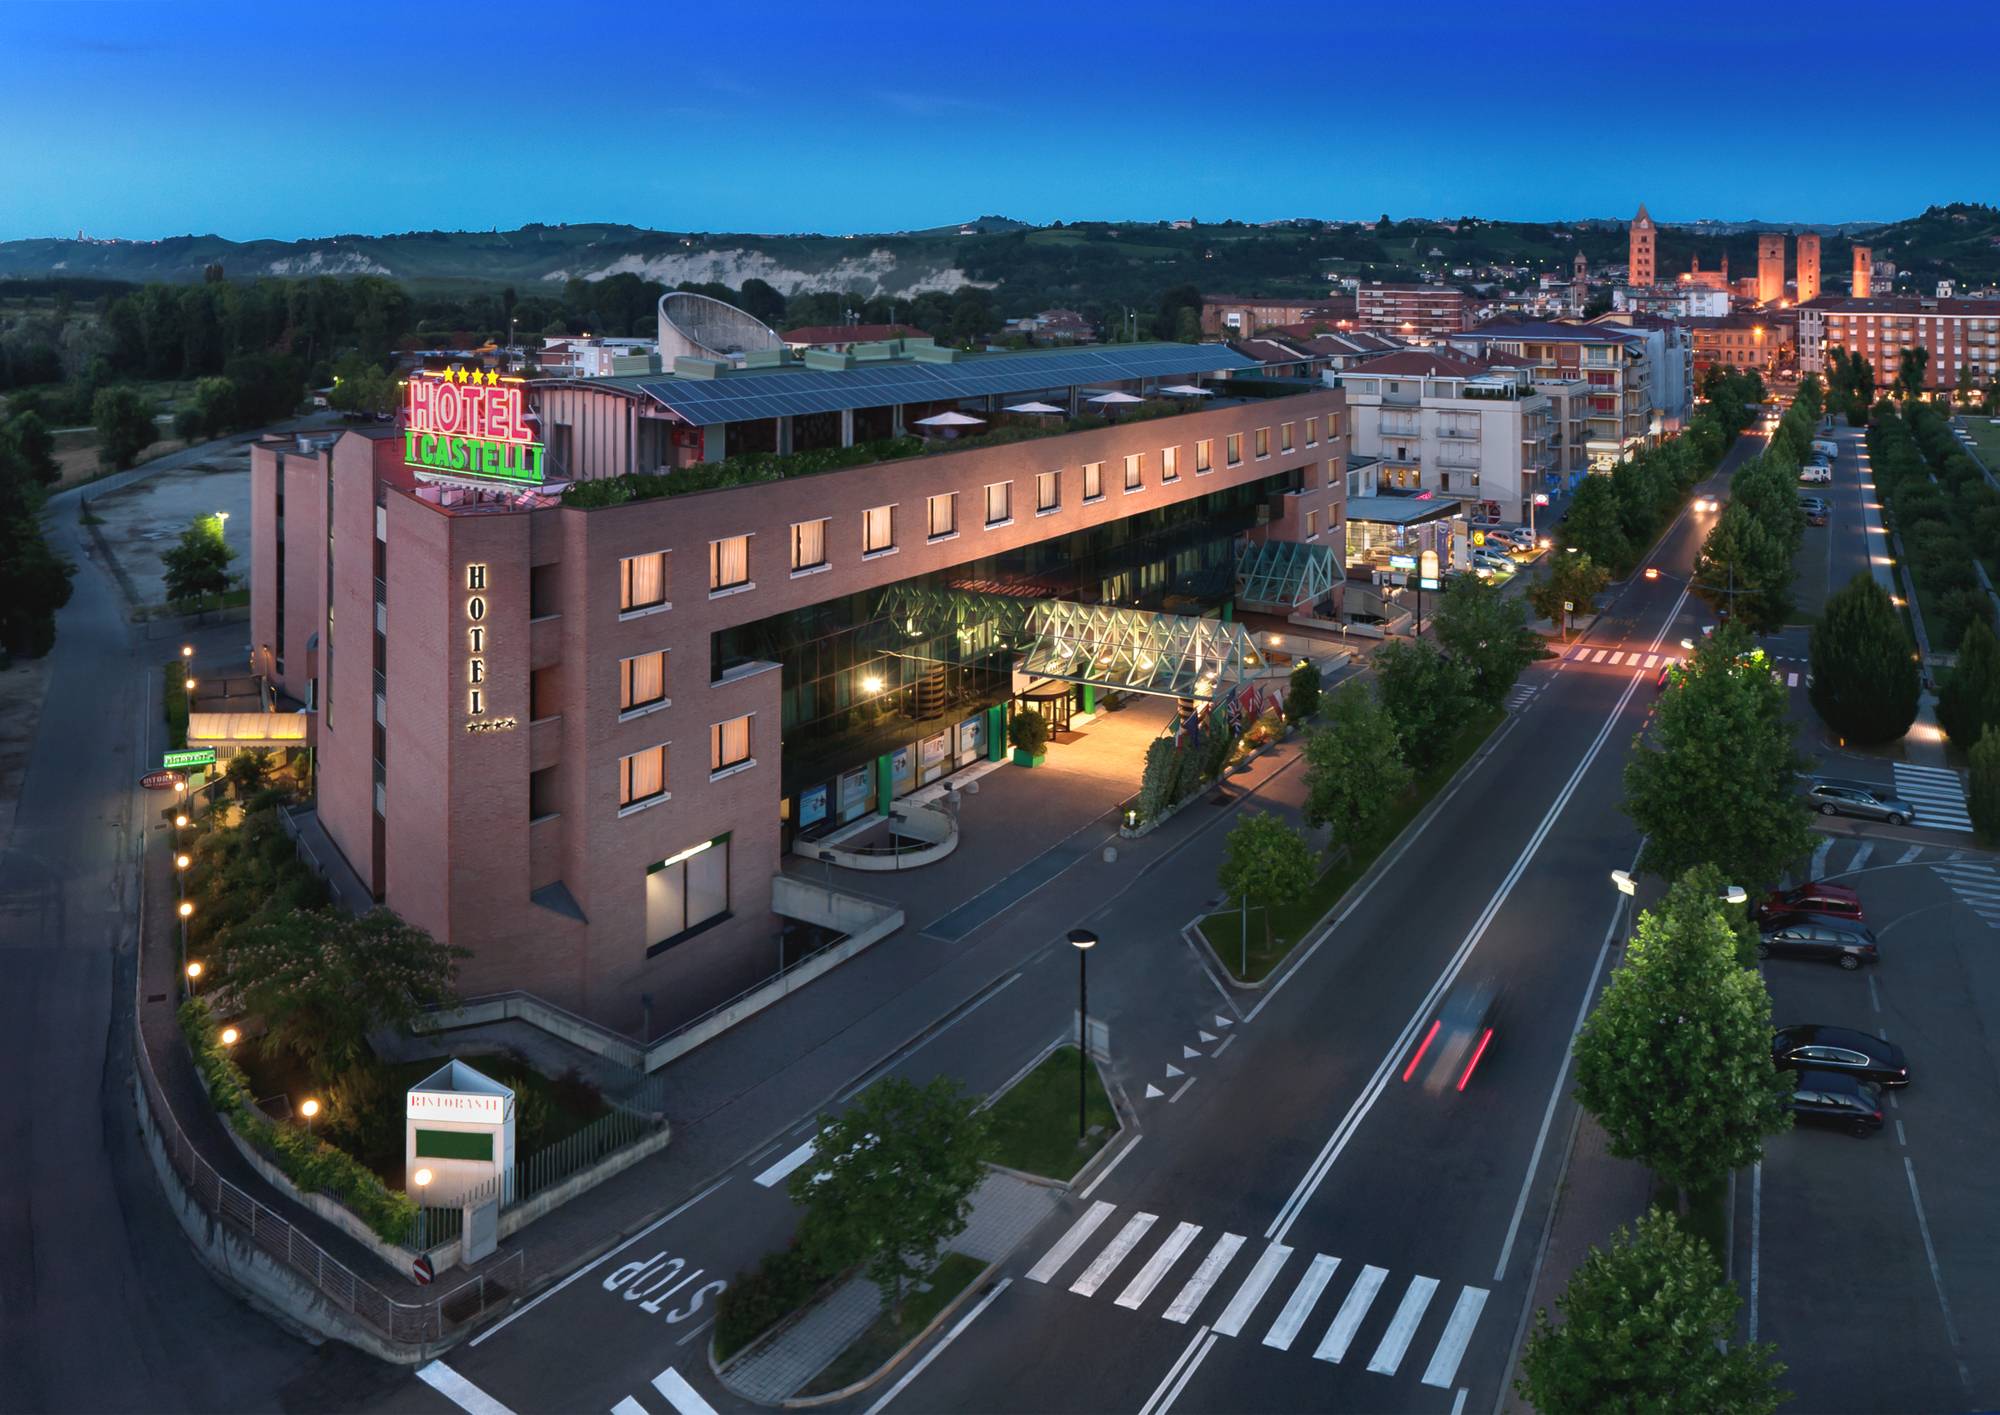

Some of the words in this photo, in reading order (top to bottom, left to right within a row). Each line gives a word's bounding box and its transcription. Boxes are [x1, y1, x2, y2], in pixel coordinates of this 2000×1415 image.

[410, 381, 532, 442] HOTEL
[405, 431, 414, 462] I
[421, 435, 544, 480] CASTELLI
[467, 565, 486, 714] HOTEL
[602, 1251, 728, 1324] STOP
